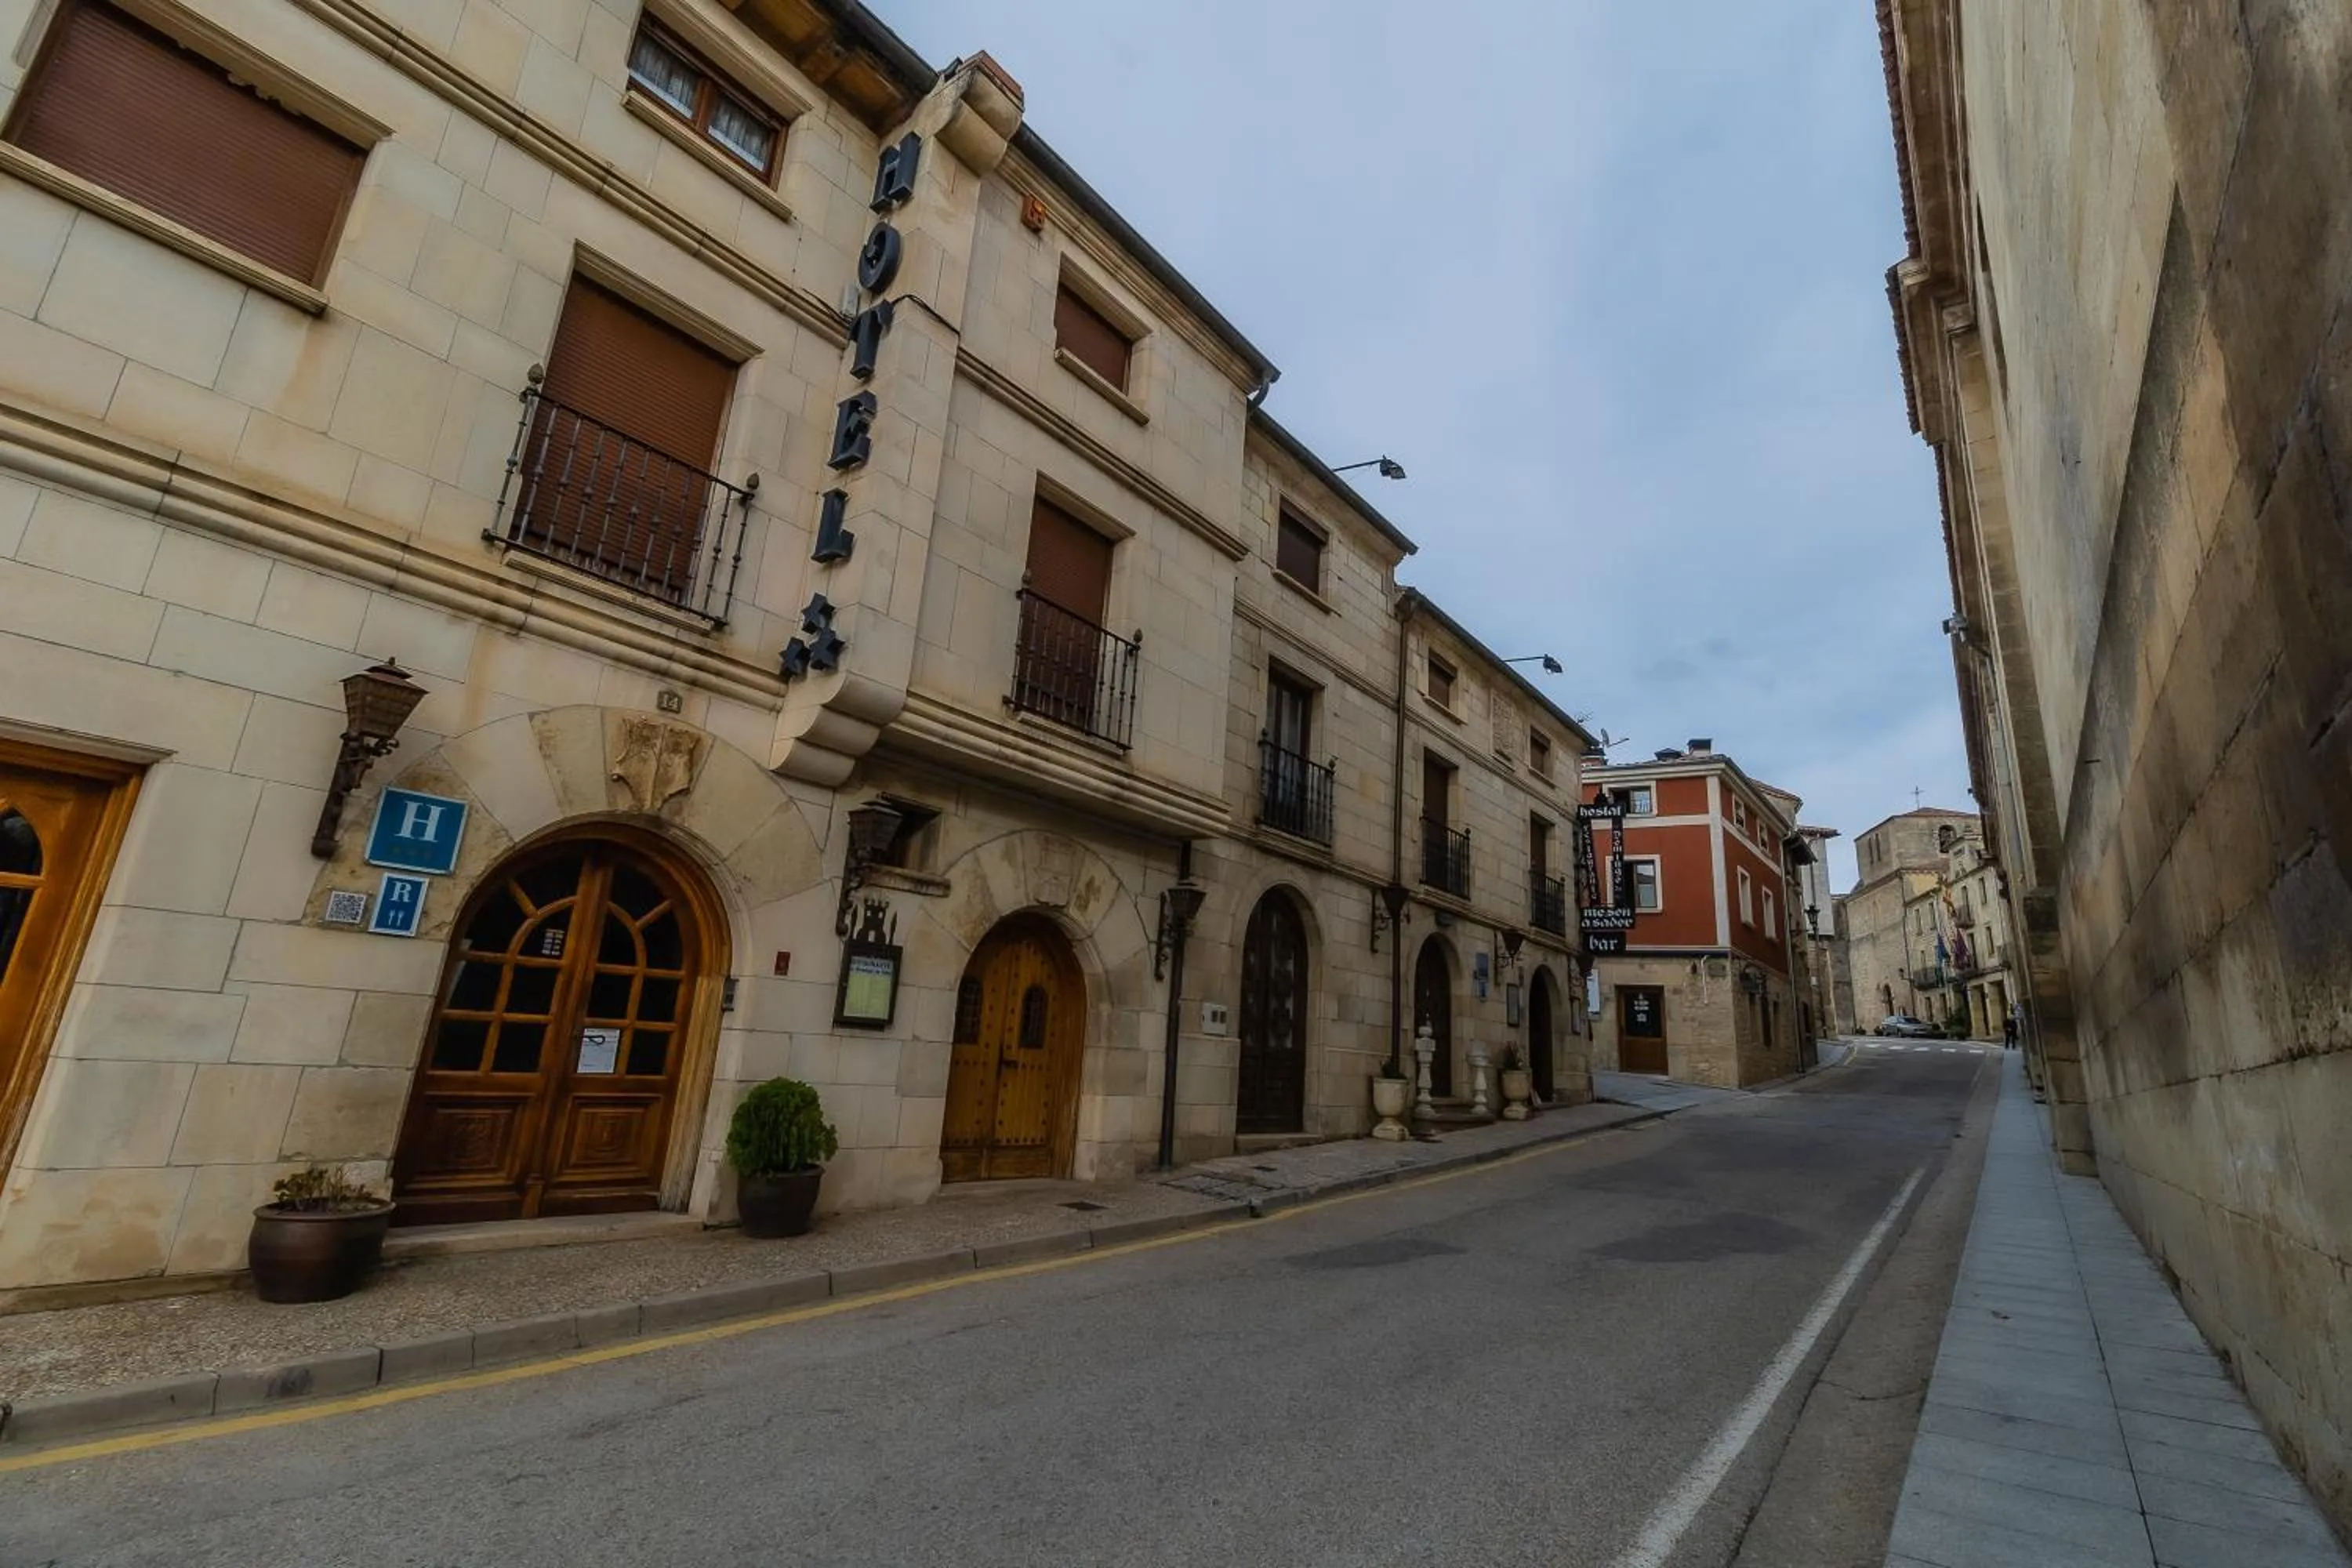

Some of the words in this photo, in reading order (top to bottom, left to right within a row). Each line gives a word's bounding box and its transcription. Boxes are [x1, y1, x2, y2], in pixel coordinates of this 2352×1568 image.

[811, 130, 921, 564] HOTEL
[395, 800, 445, 843] H
[391, 881, 412, 903] R
[1589, 934, 1619, 951] bar
